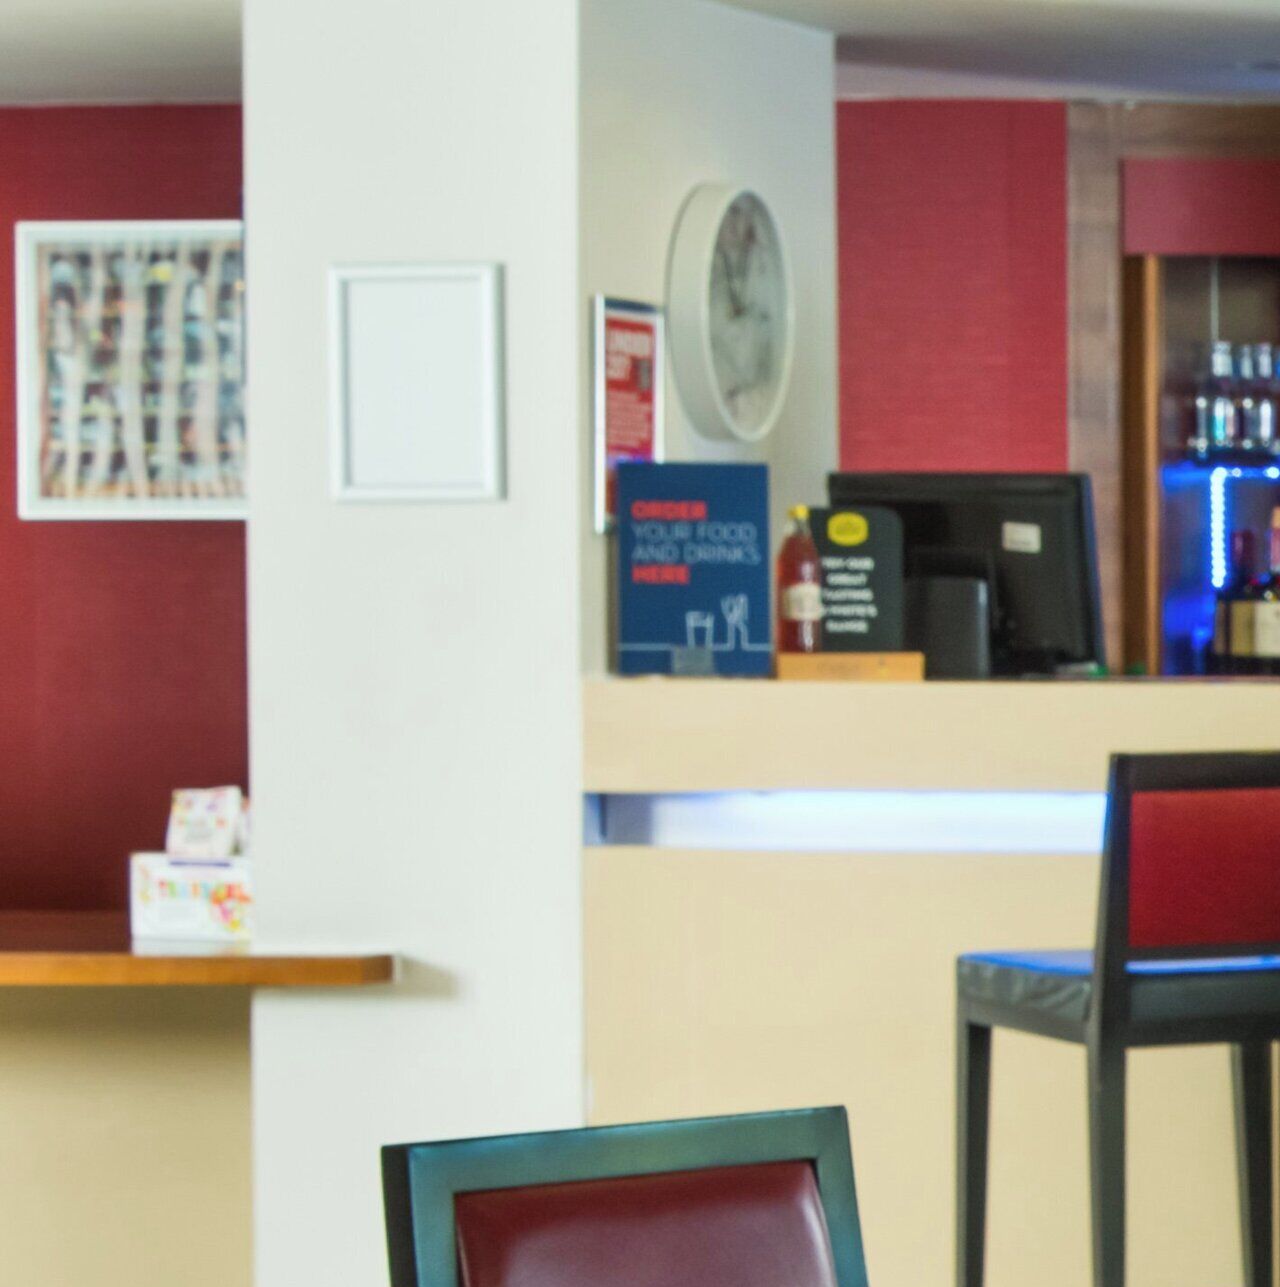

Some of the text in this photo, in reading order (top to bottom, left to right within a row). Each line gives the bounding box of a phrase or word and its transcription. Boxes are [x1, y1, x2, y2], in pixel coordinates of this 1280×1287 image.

[631, 500, 708, 521] ORDER
[631, 522, 758, 542] YOUR FOOD
[632, 543, 761, 565] AND DRINKS
[632, 564, 690, 584] HERE
